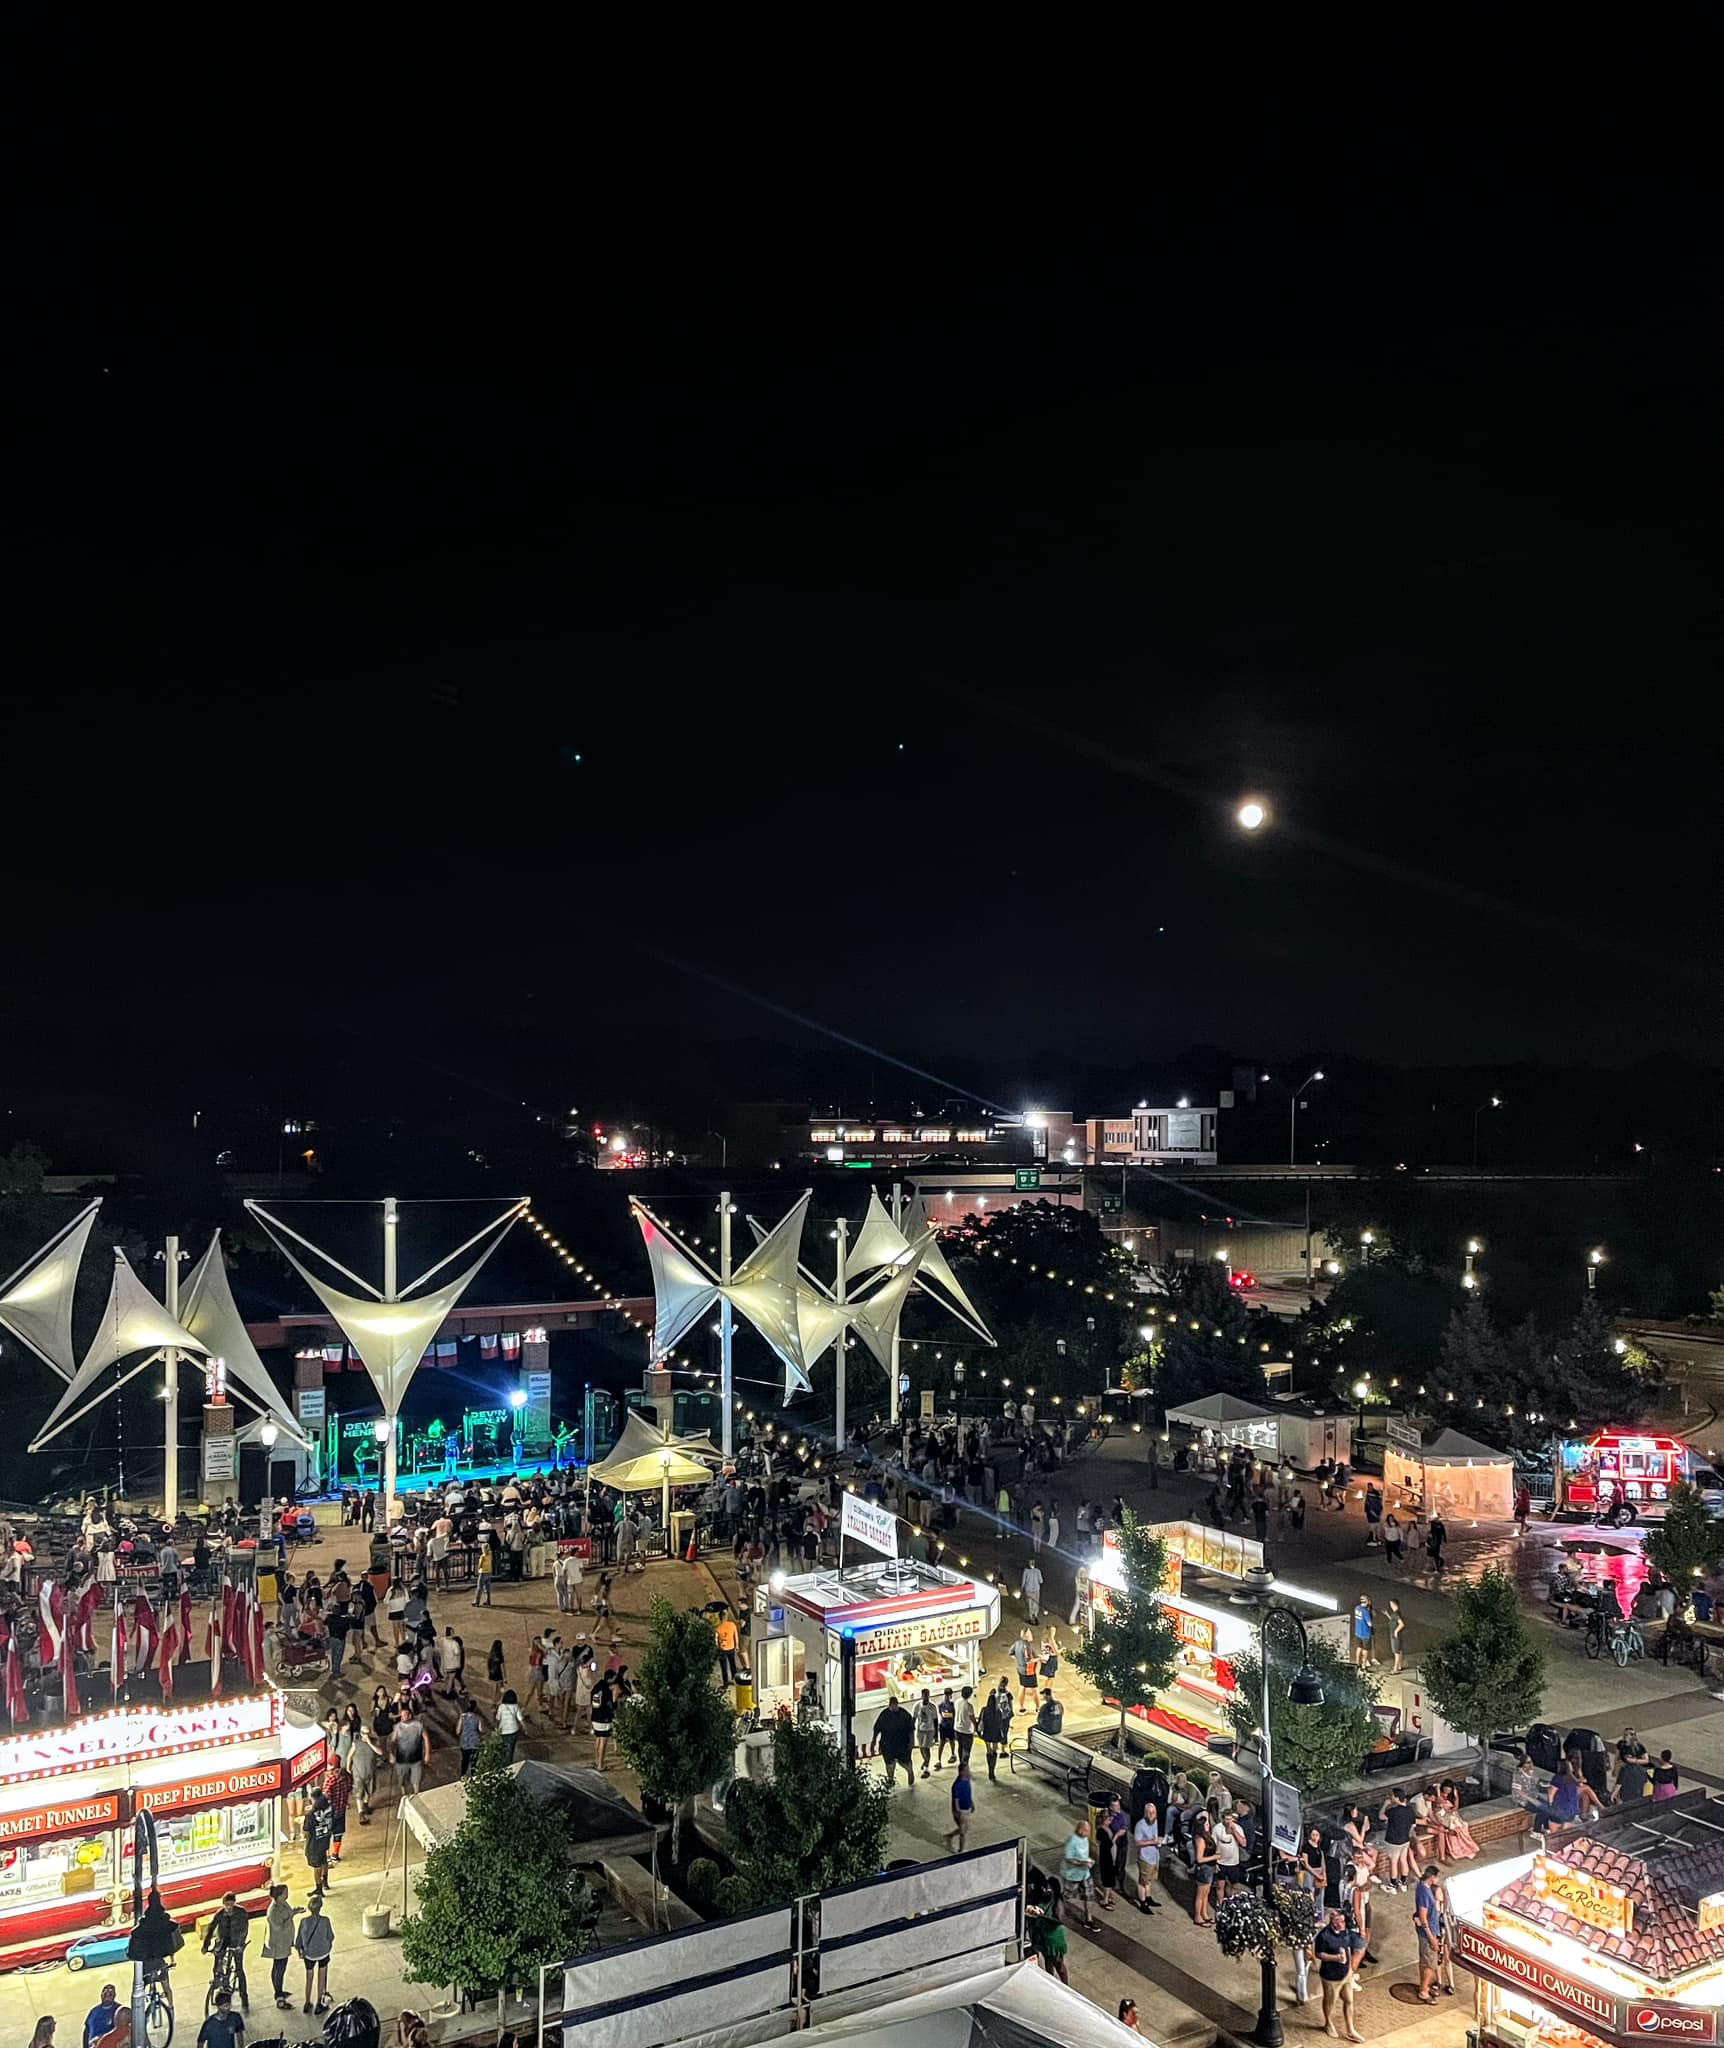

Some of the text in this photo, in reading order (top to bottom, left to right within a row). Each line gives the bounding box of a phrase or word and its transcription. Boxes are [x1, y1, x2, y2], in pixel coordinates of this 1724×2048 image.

[920, 1620, 980, 1643] SAUSAGE
[143, 1771, 276, 1810] DEEP FRIED OREOS
[46, 1803, 111, 1829] FUNNELS
[1463, 1935, 1610, 2020] STROMBOLI CAVATELLI
[1660, 2018, 1704, 2032] pepsi
